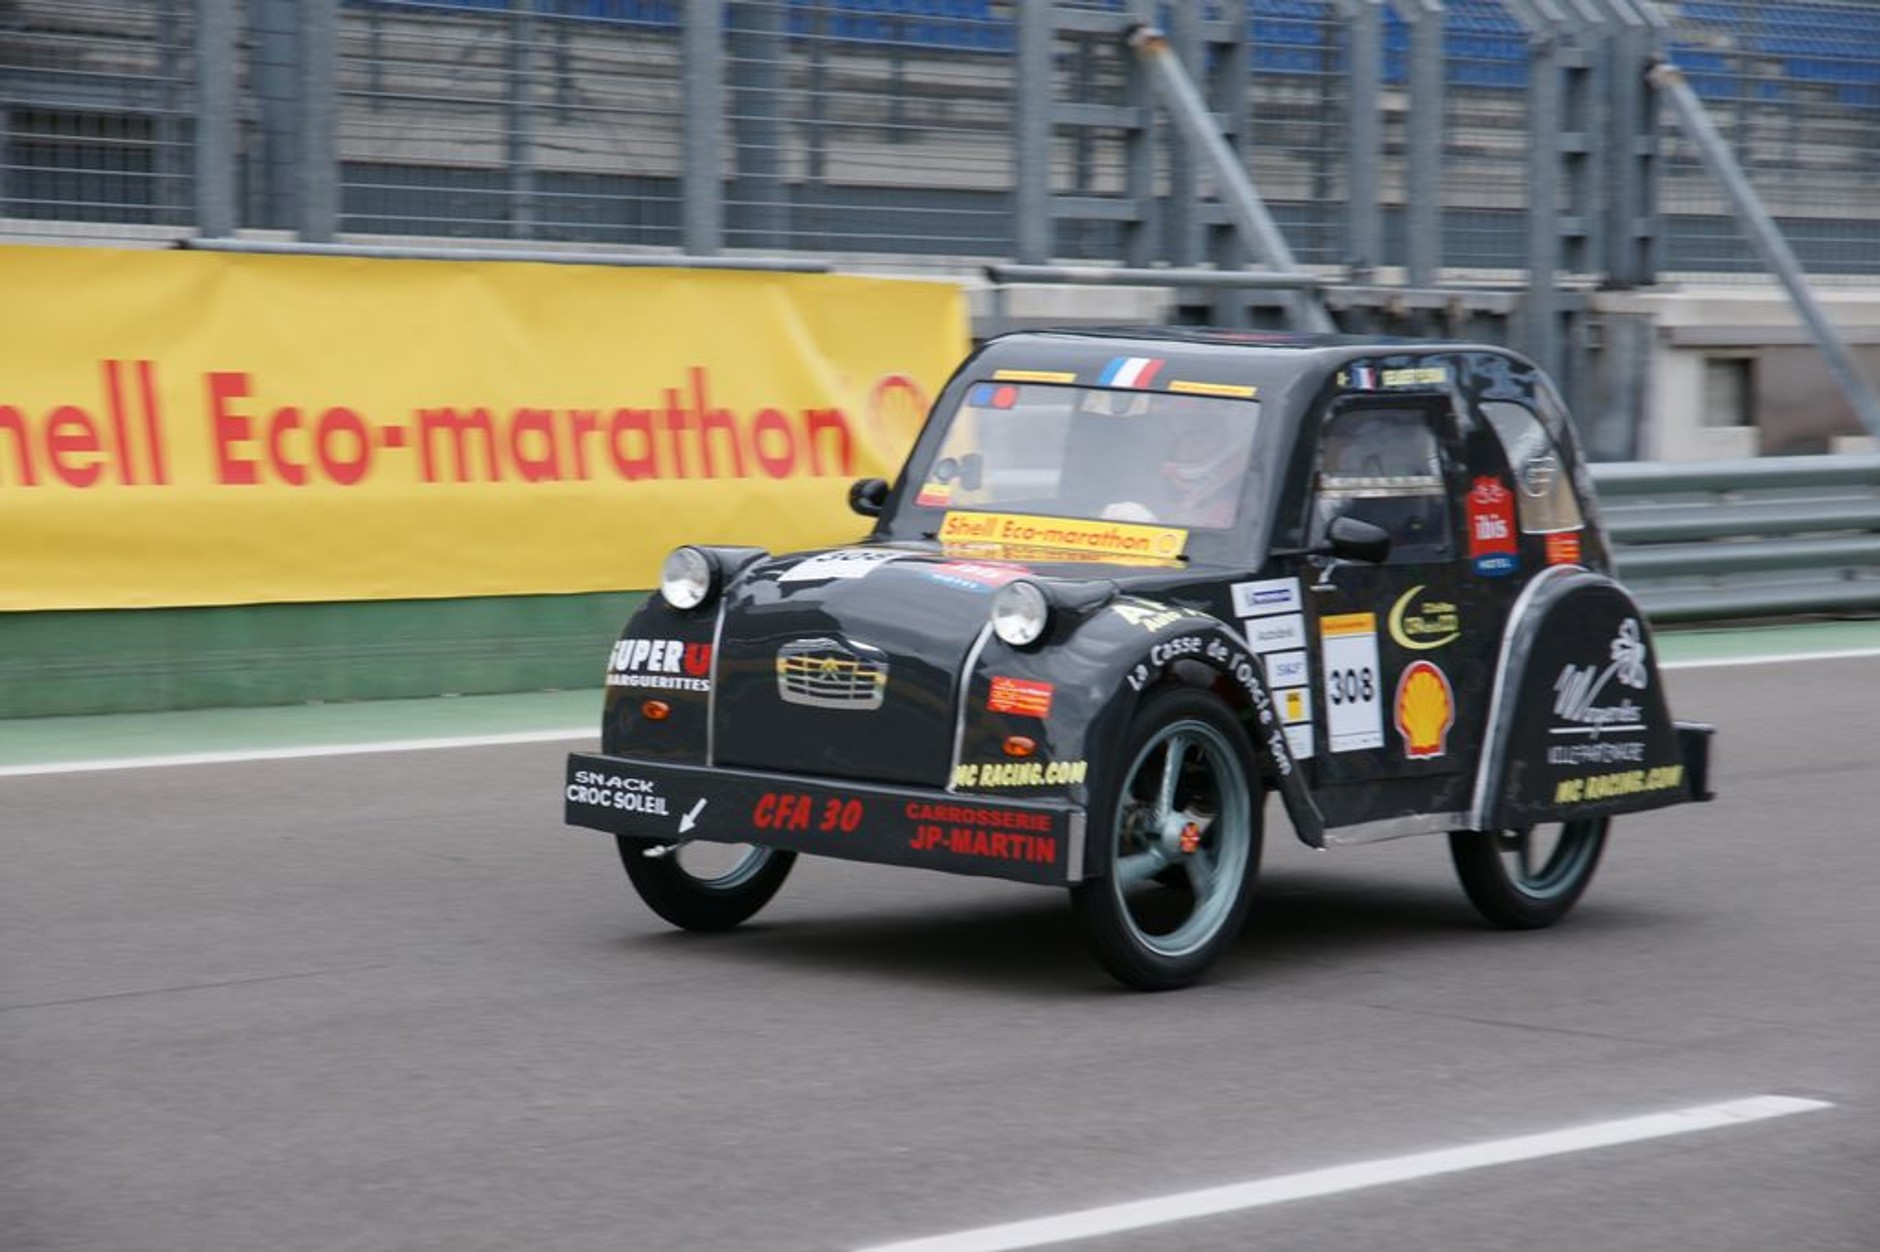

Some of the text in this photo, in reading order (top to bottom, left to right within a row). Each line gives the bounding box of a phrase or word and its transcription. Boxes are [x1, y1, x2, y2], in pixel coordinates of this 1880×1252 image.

[203, 366, 856, 487] Eco-marathon
[946, 516, 1150, 551] Shell Eco-marathon
[1474, 513, 1508, 540] ibis
[685, 642, 713, 676] U
[1127, 664, 1149, 692] La
[1151, 637, 1202, 666] Casse
[1206, 638, 1230, 662] de
[1329, 667, 1374, 705] 308
[575, 771, 654, 793] SNACK
[980, 760, 1088, 787] RACING.COM
[1584, 765, 1684, 800] RACING.COM
[567, 784, 670, 816] CROC SOLEIL
[753, 793, 864, 832] CFA 30
[905, 802, 1052, 832] CARROSSERIE
[910, 825, 1056, 863] JP-MARTIN
